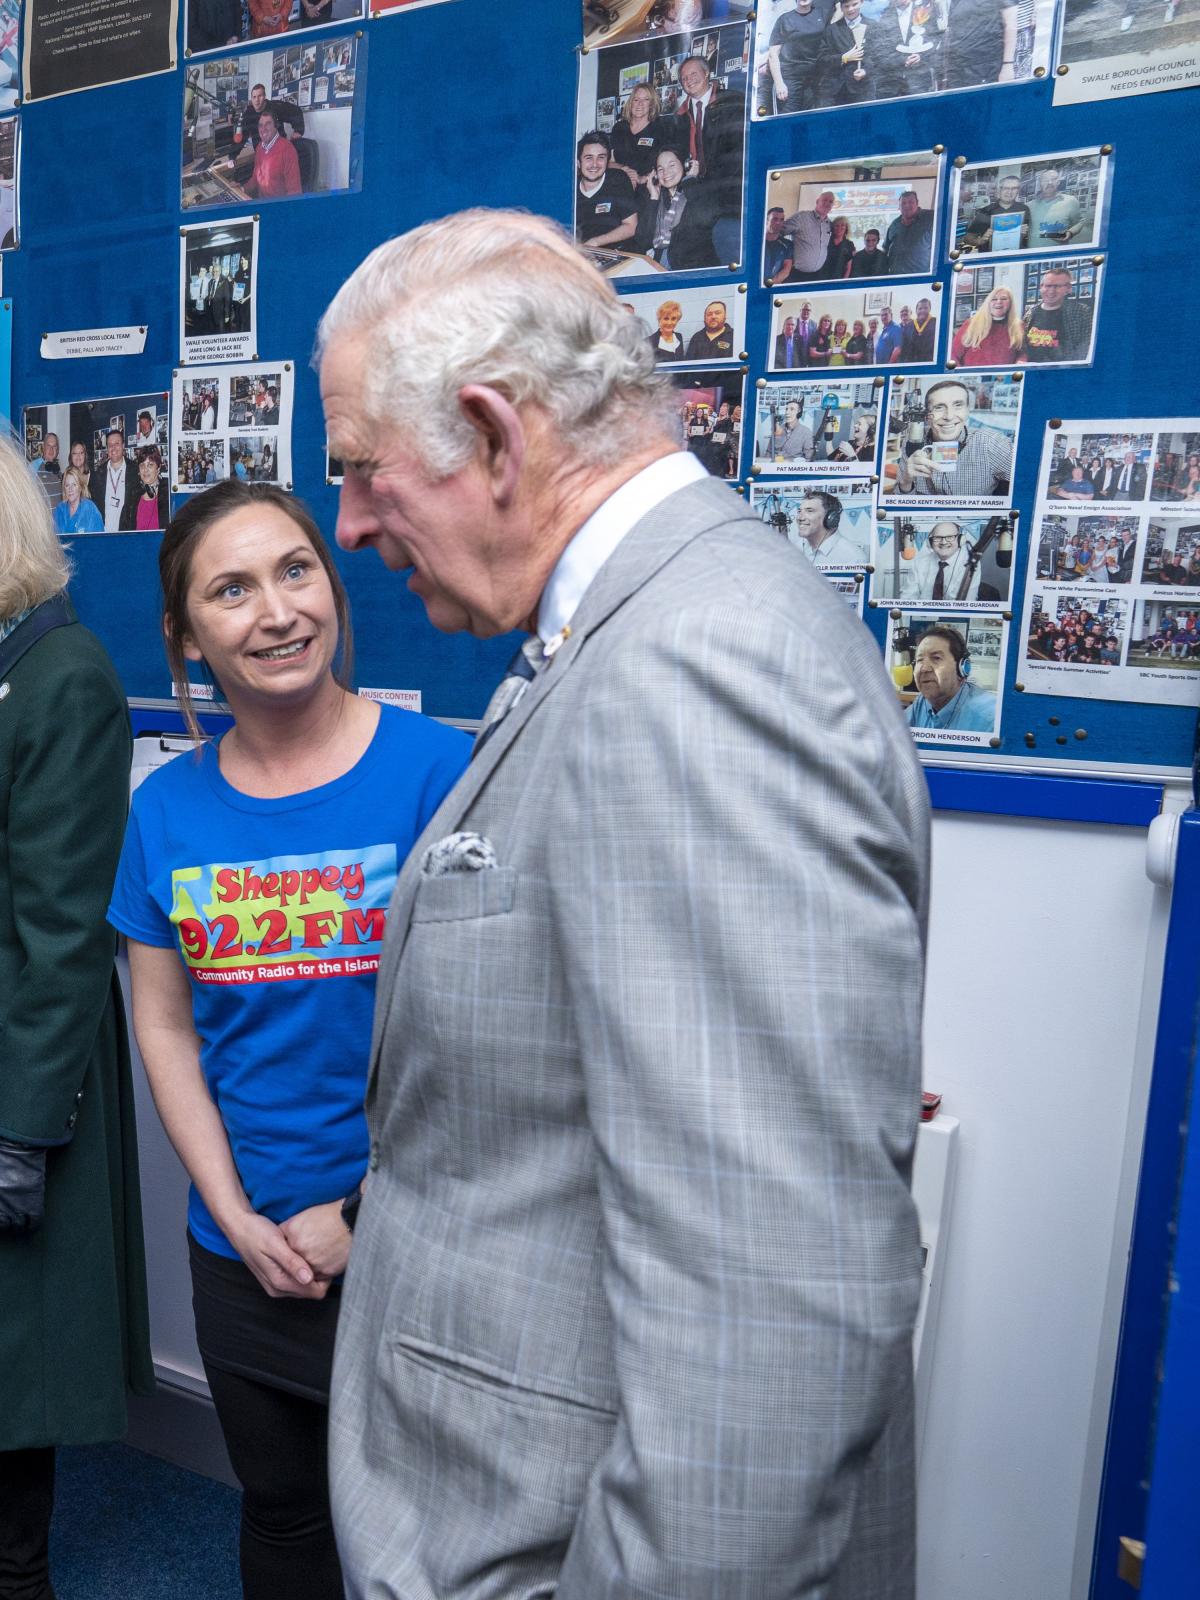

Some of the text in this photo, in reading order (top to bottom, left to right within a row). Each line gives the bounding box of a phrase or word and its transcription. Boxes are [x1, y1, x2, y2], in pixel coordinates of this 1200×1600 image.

[1082, 59, 1197, 84] SWALE BOROUGH COUNCIL
[1110, 81, 1138, 91] NEEDS
[1140, 74, 1183, 86] ENJOYING
[202, 337, 228, 345] VOLUNTEER
[360, 690, 419, 701] MUSIC CONTENT
[911, 732, 981, 743] ORDON HENDERSON
[216, 862, 365, 907] Sheppey
[178, 908, 388, 960] 92.2 FM
[196, 969, 254, 982] Community
[258, 965, 294, 978] Radio
[298, 963, 316, 975] for
[318, 961, 342, 973] the
